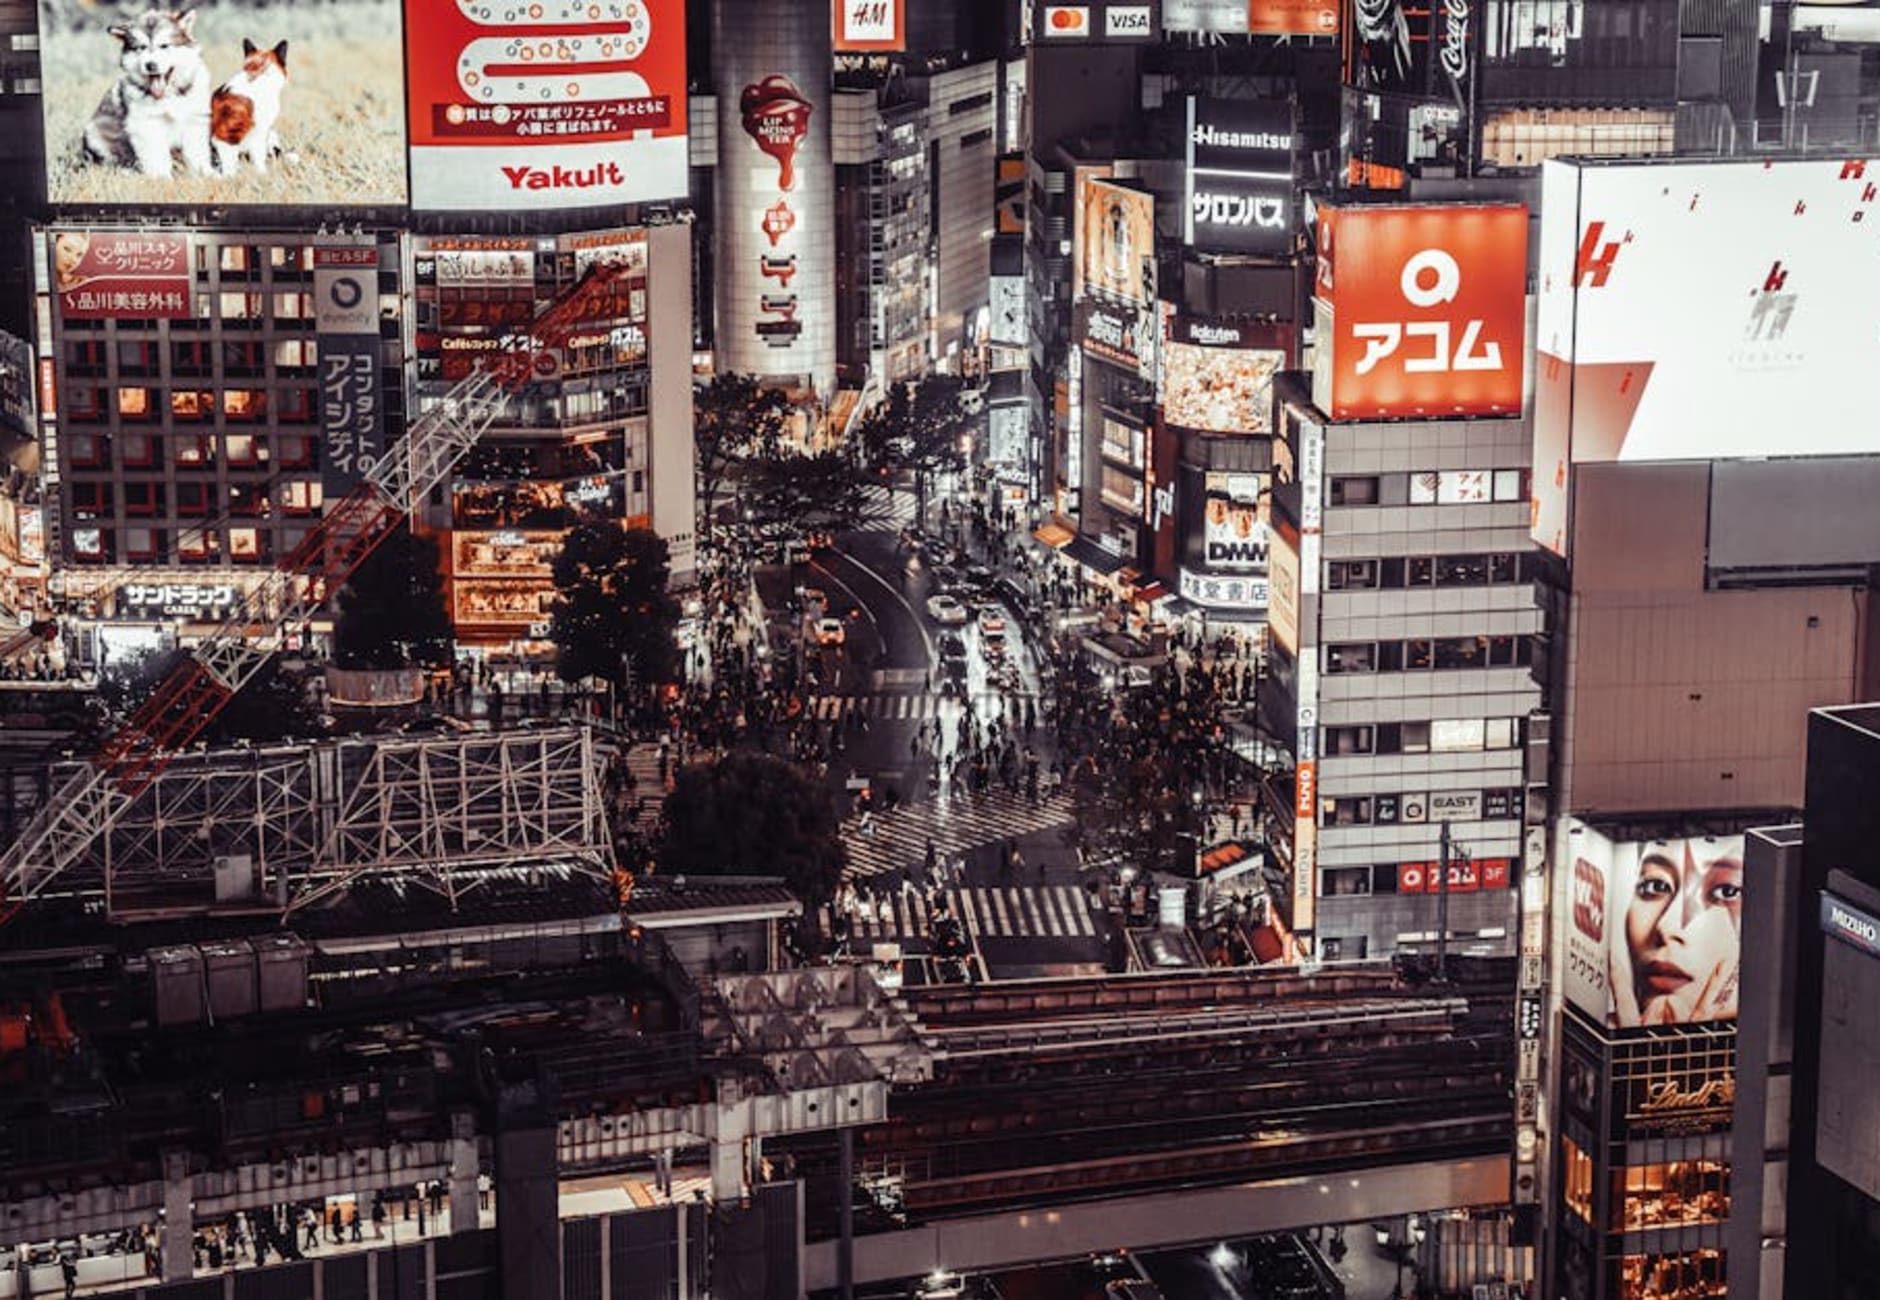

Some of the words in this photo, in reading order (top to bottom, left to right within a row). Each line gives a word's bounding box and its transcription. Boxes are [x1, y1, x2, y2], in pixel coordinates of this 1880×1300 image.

[1111, 14, 1149, 29] VISA
[762, 116, 783, 126] LIP
[1193, 123, 1291, 150] Hisamitsu
[501, 162, 625, 190] Yakult
[1193, 192, 1286, 229] サロンパス
[113, 239, 182, 256] 品川スキン
[115, 256, 176, 271] クリニック
[76, 291, 184, 311] 品川美容外科
[1352, 319, 1504, 377] アコム
[323, 353, 354, 473] アイシティ
[354, 354, 377, 472] コンタクトの
[126, 585, 233, 605] サンドラッグ
